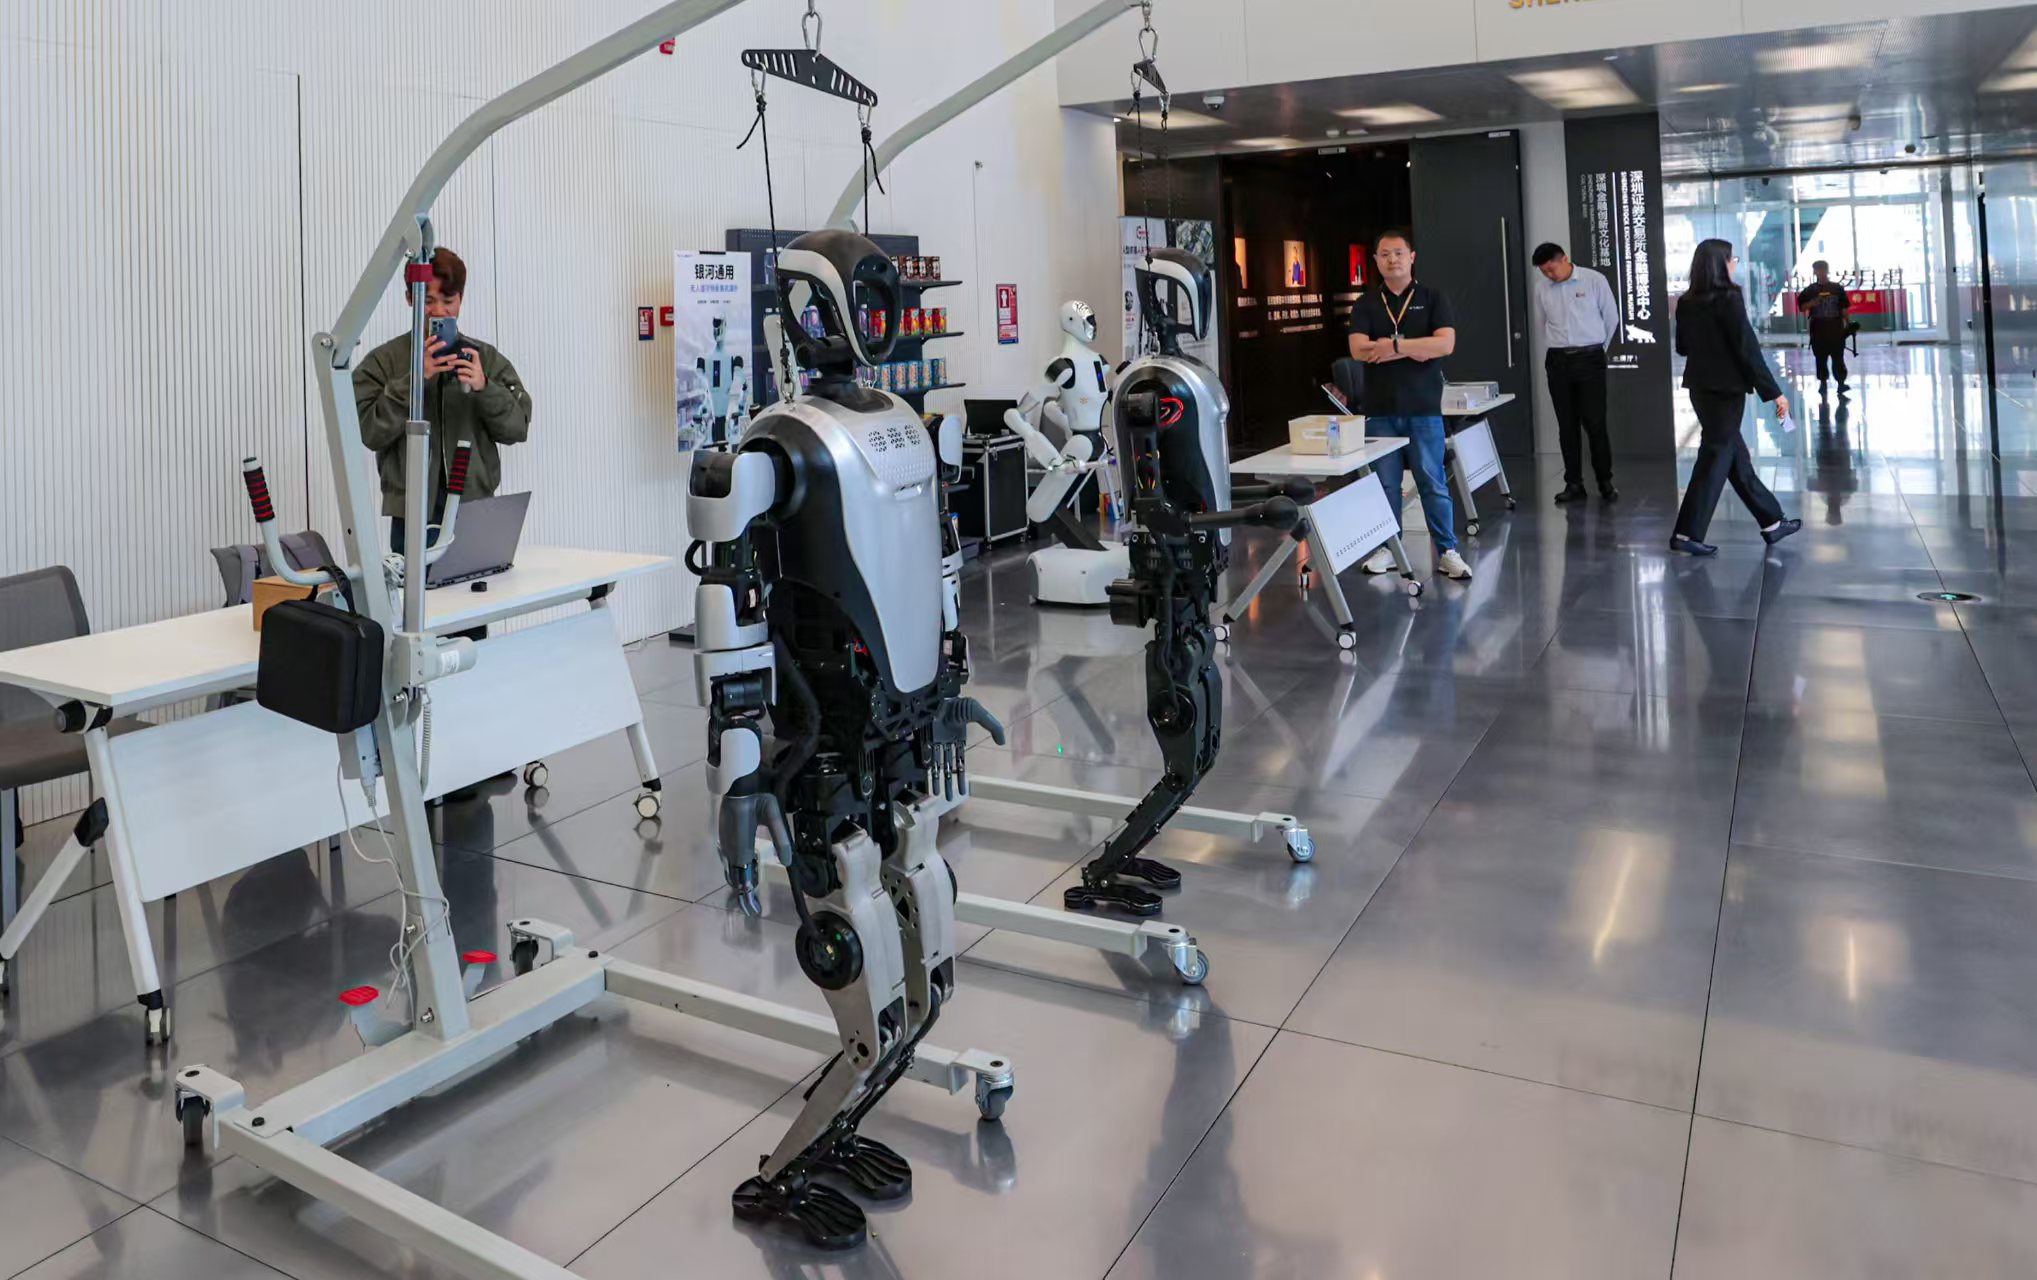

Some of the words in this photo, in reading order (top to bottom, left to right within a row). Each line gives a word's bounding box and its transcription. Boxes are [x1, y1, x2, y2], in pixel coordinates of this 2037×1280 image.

[1622, 204, 1630, 225] STOCK
[1624, 226, 1632, 259] EXCHANGE
[695, 263, 734, 280] 银河通用
